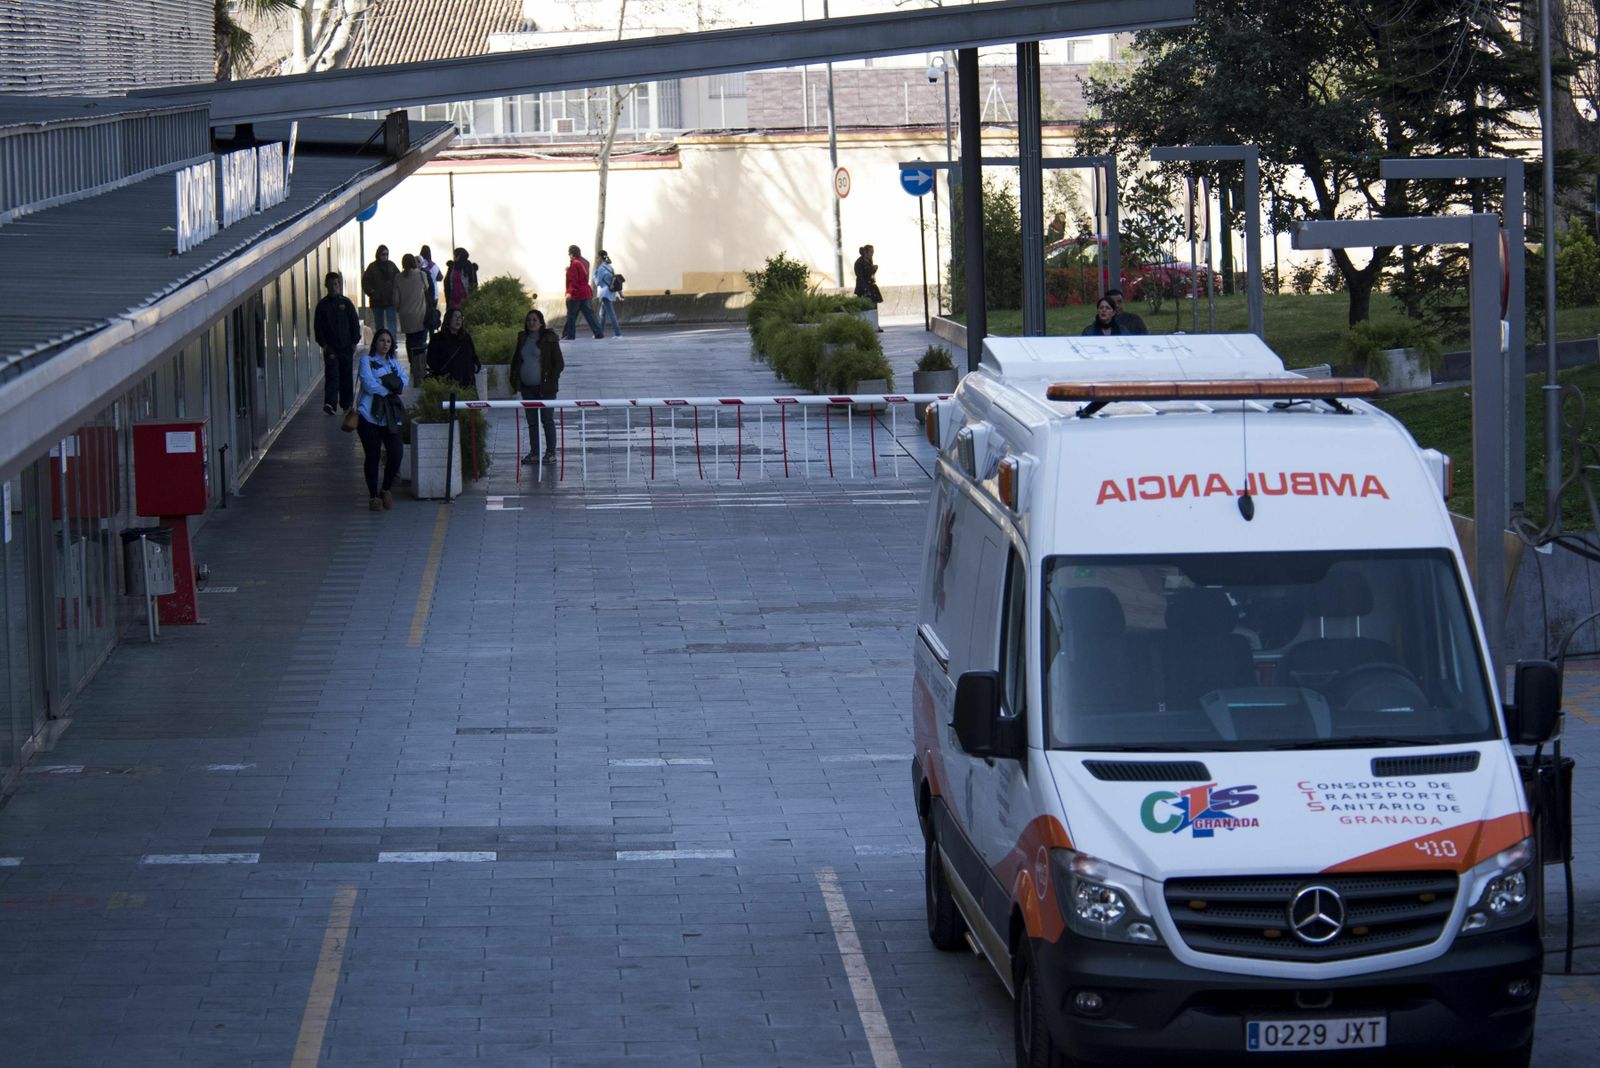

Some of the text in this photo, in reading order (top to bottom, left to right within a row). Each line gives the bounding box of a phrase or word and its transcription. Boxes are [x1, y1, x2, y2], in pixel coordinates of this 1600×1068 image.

[1297, 781, 1453, 790] CONSORCIO DE
[1301, 791, 1457, 801] TRANSPORTE
[1140, 782, 1260, 834] CTS
[1307, 802, 1462, 813] SANITARIO DE
[1194, 817, 1260, 829] GRANADA
[1339, 815, 1443, 825] GRANADA
[1414, 839, 1458, 857] 410
[1265, 1024, 1327, 1046] 0229
[1336, 1021, 1380, 1044] JXT
